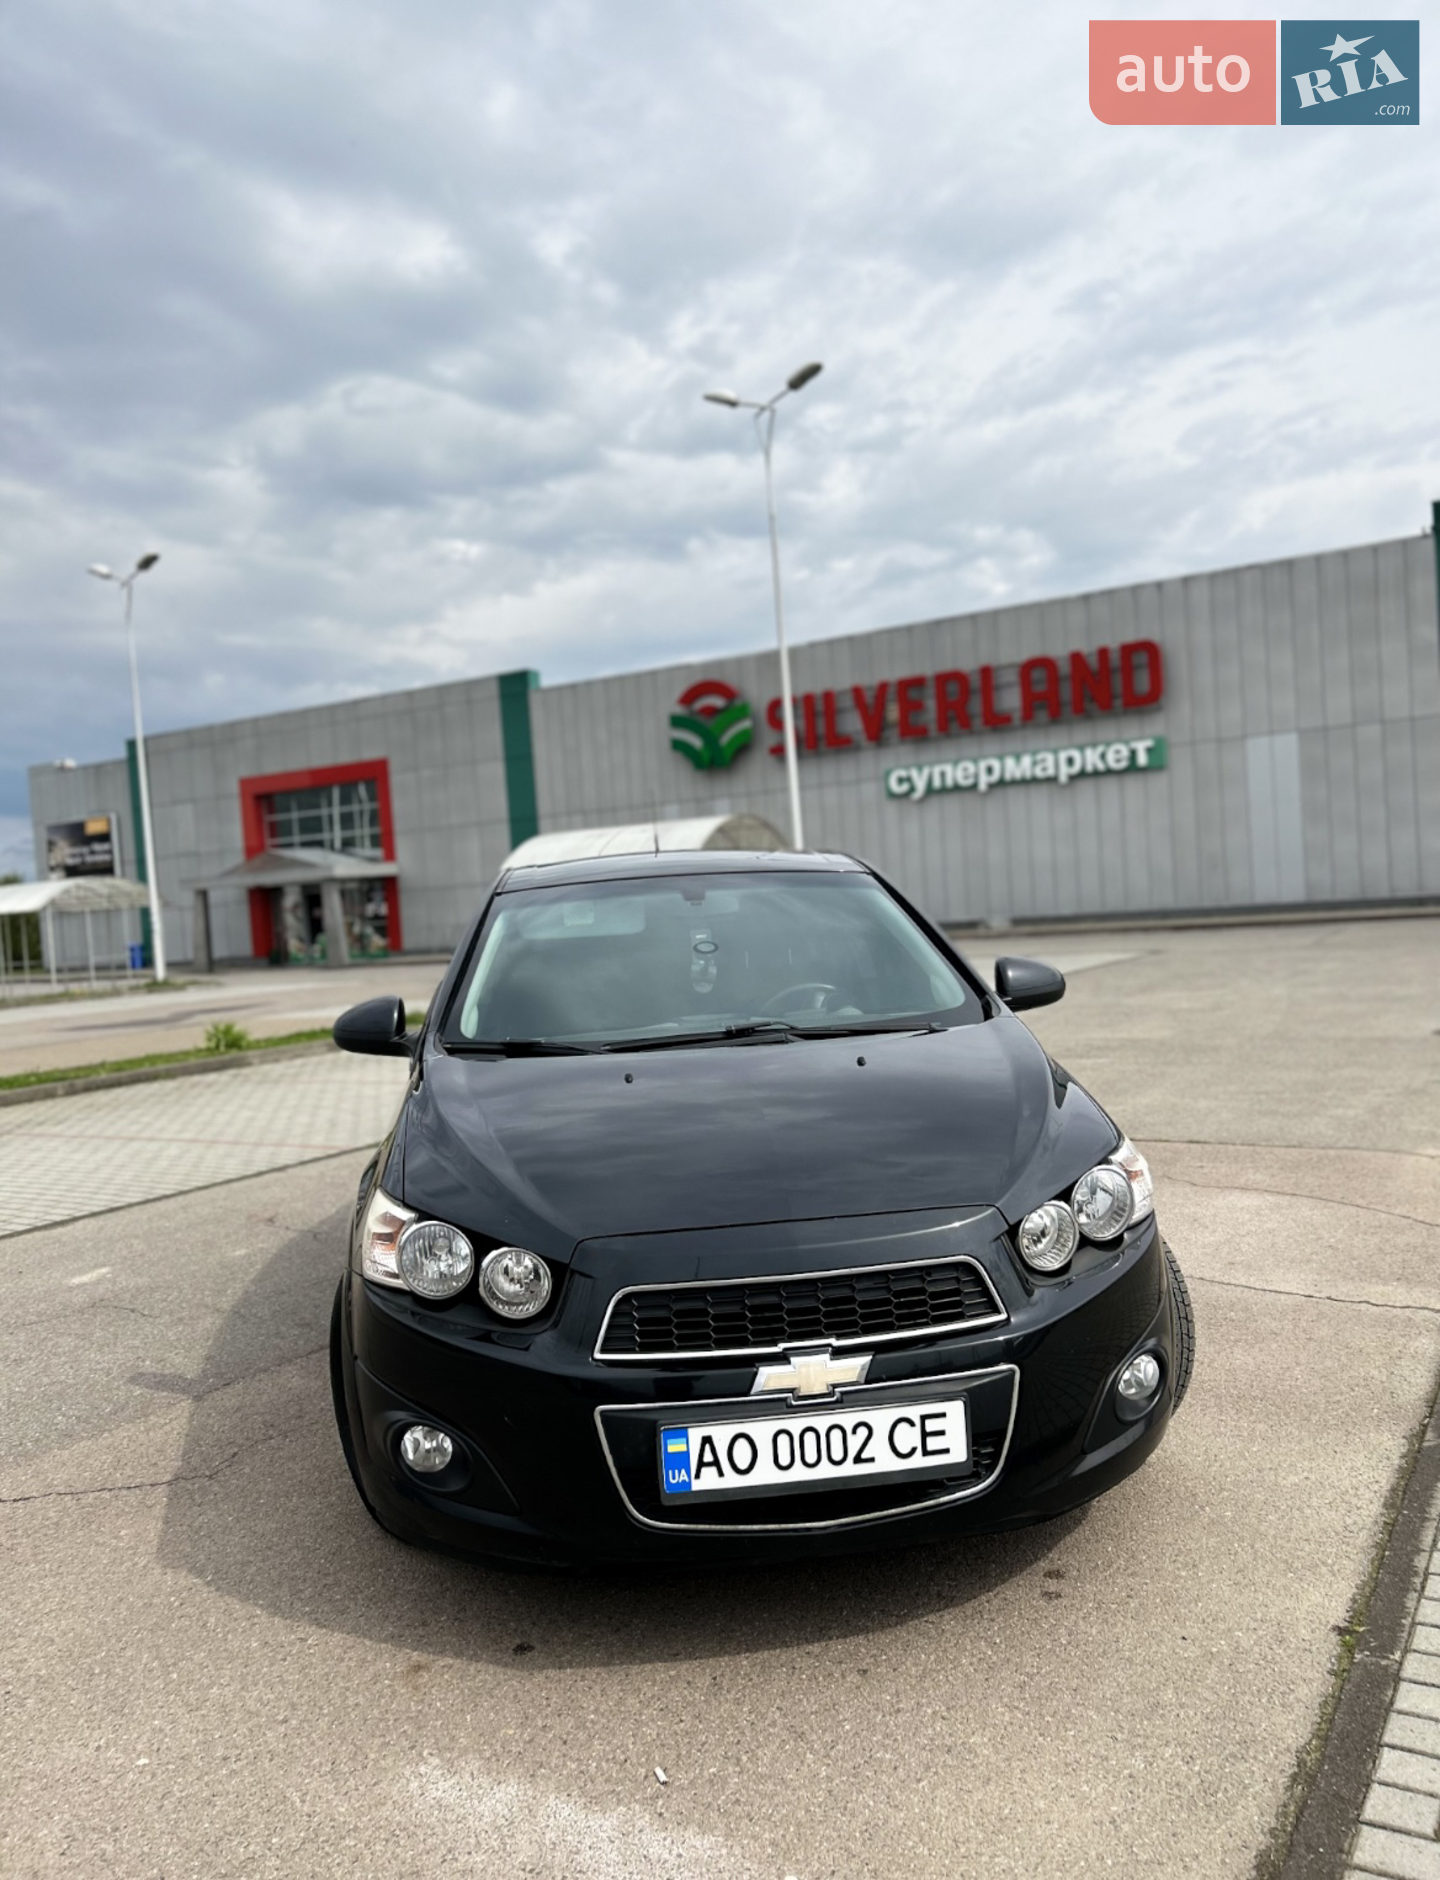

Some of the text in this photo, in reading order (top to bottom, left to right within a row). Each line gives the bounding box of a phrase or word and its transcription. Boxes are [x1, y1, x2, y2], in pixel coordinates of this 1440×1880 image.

[766, 638, 1164, 756] SILVERLAND
[887, 738, 1155, 799] супермаркет
[669, 1468, 690, 1484] UA
[694, 1411, 951, 1480] AO 0002 CE
